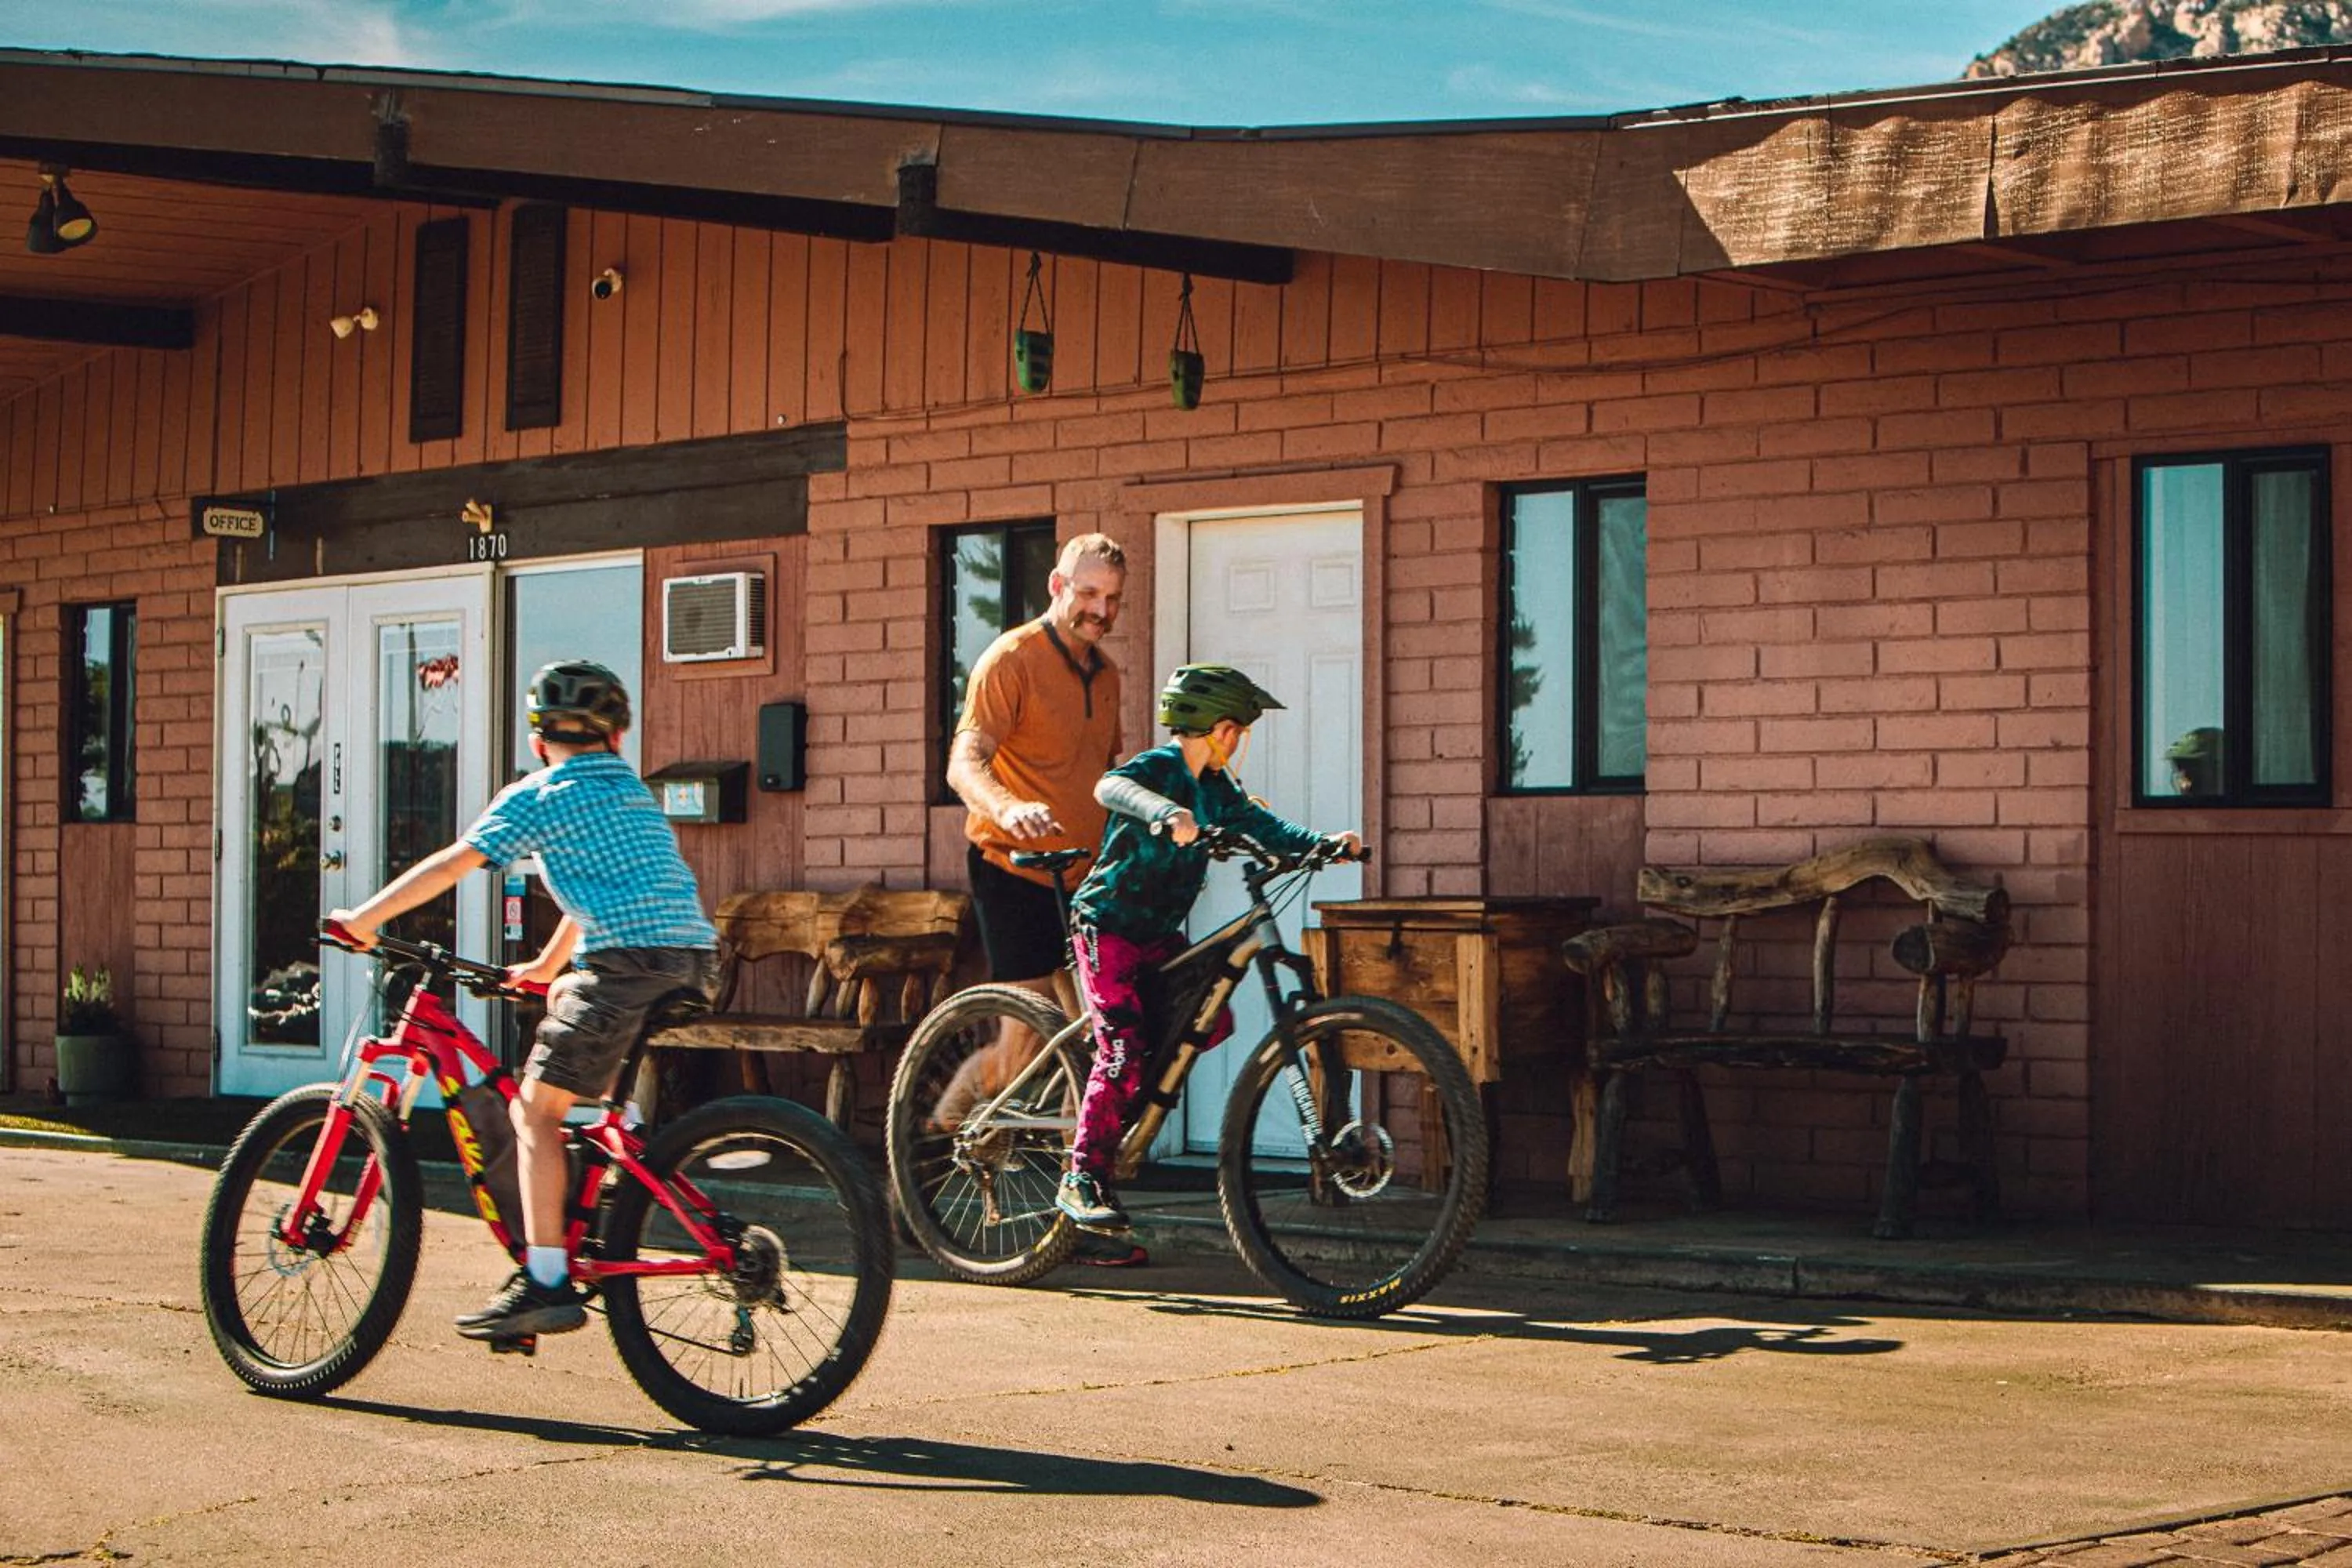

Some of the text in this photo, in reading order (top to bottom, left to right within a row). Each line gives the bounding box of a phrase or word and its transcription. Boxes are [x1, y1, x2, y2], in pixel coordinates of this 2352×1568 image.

[209, 514, 257, 532] OFFICE
[470, 534, 507, 560] 1870
[1340, 1276, 1402, 1305] MAXXIS
